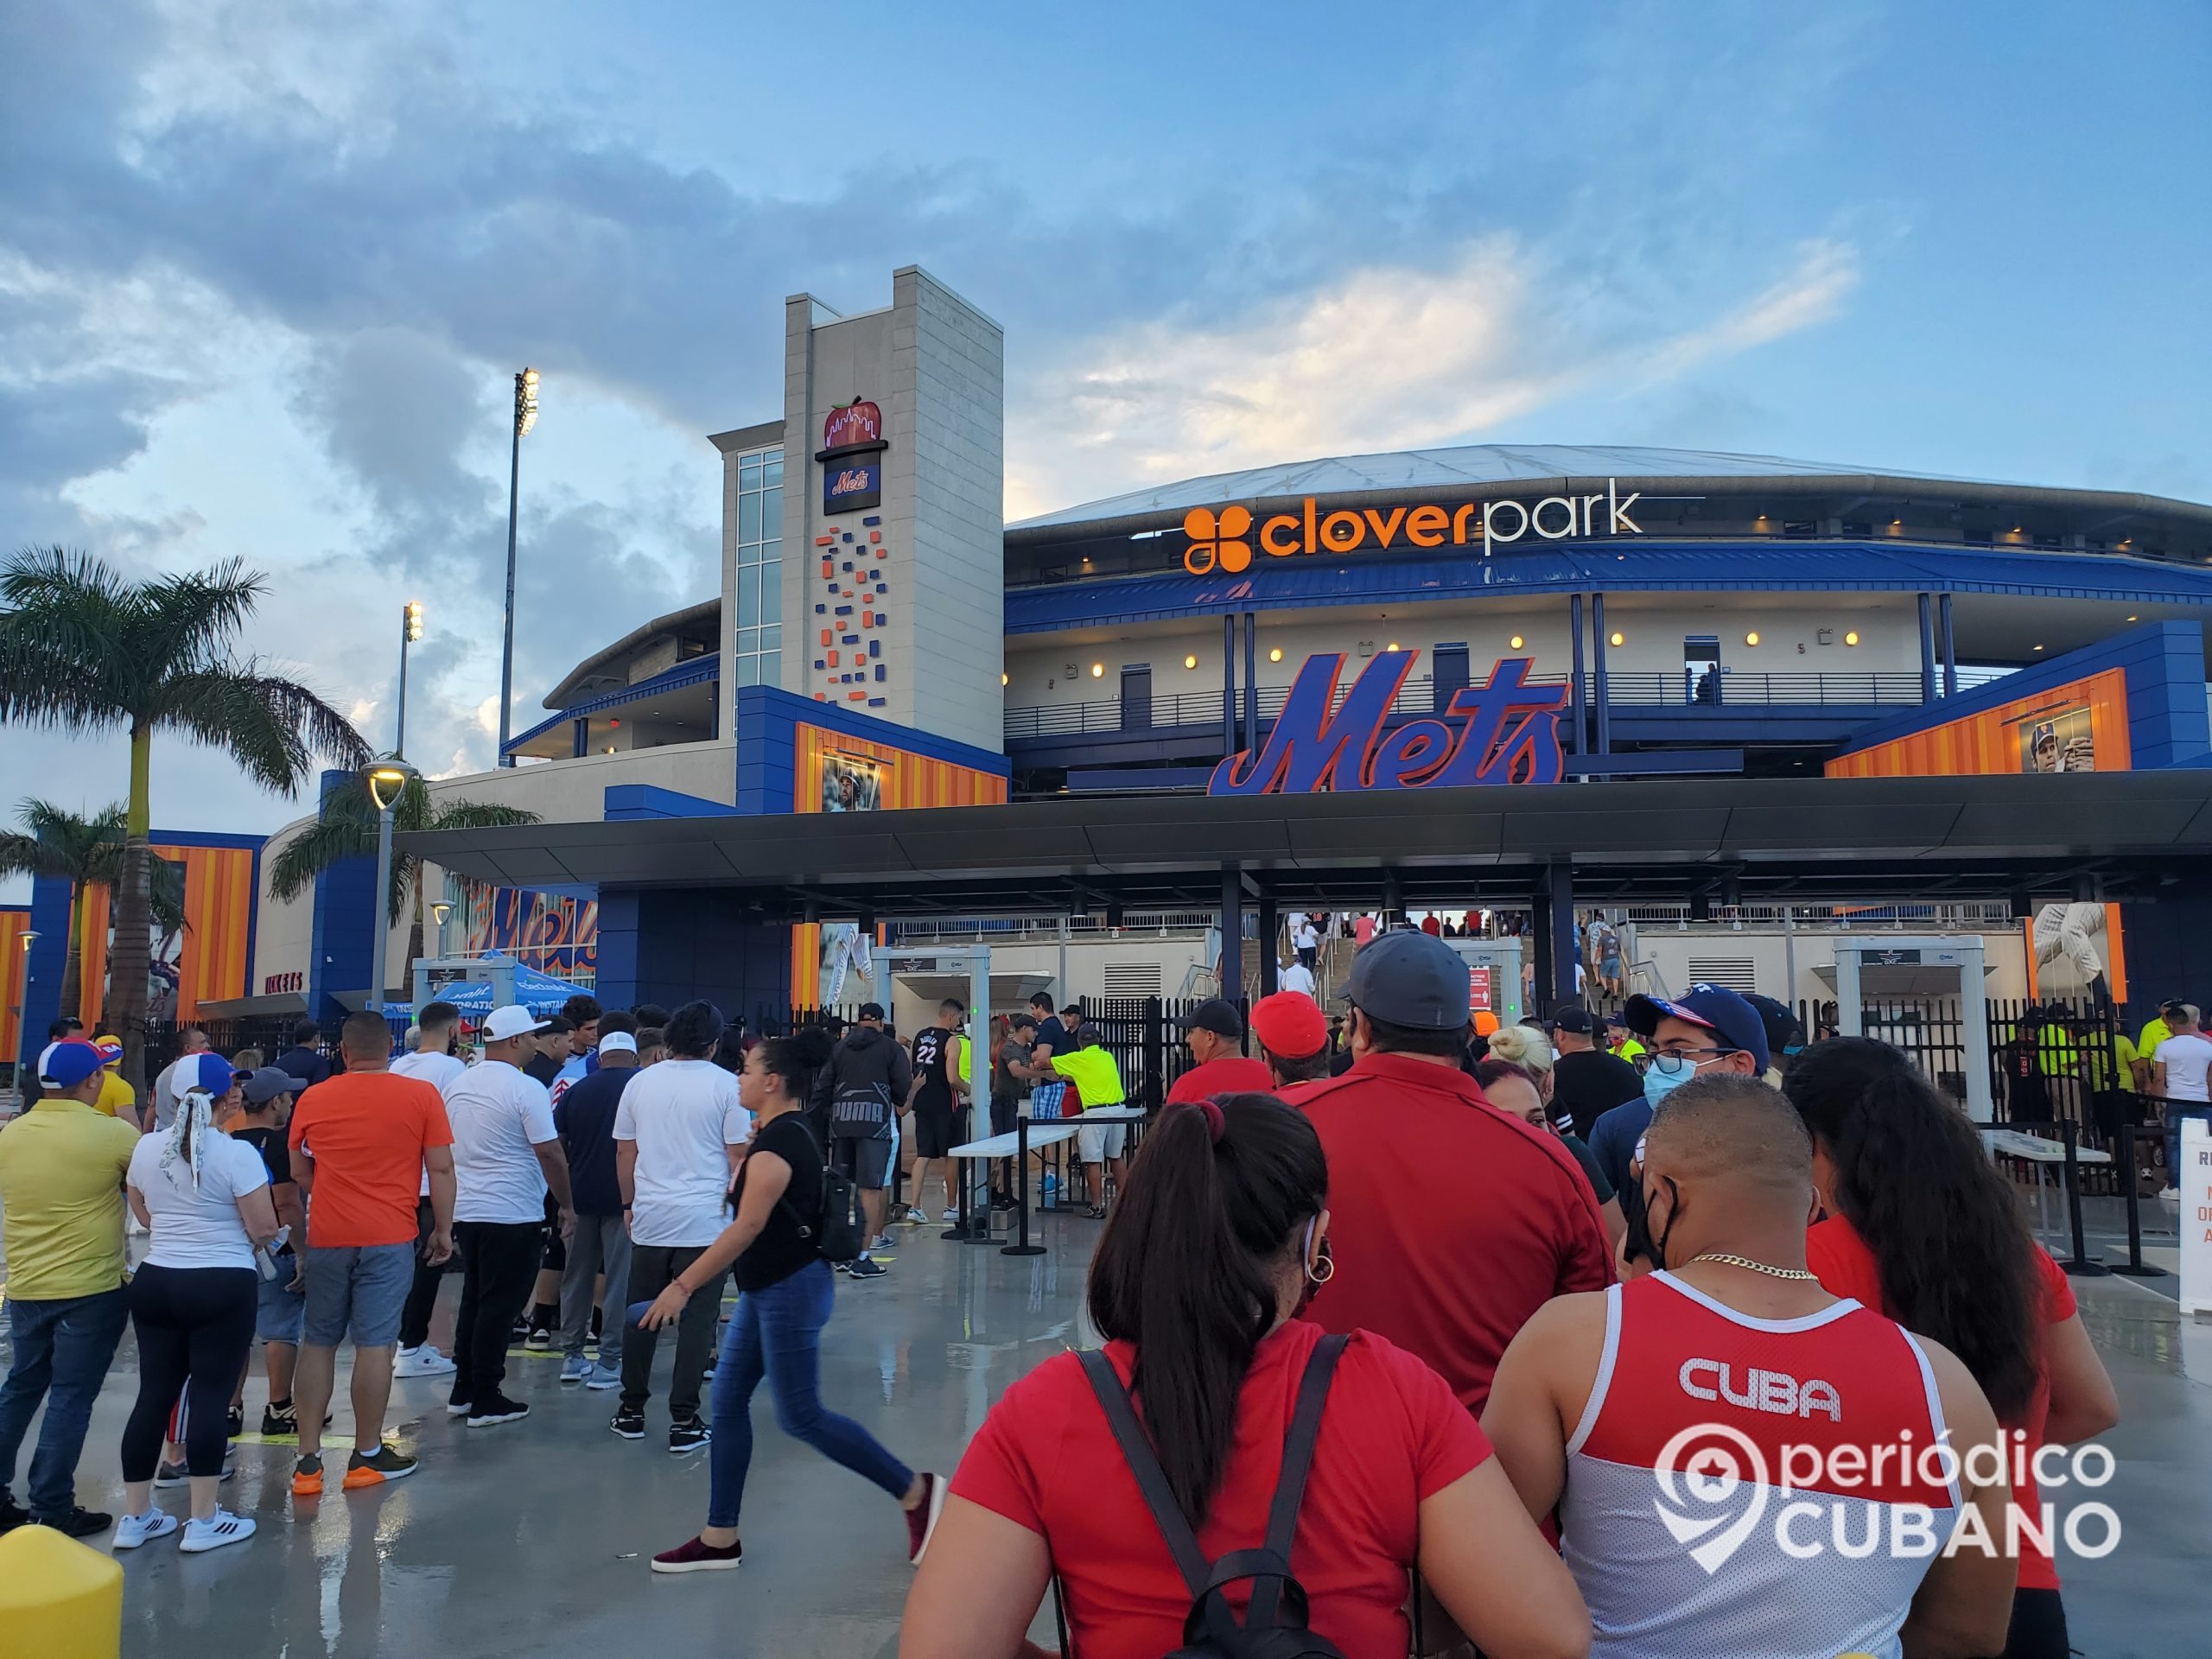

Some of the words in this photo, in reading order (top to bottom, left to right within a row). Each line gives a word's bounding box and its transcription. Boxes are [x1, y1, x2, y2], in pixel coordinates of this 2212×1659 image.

[831, 470, 869, 496] Mets
[1206, 649, 1573, 798] Mets
[264, 971, 303, 995] TICKETS
[916, 1045, 937, 1065] 22
[831, 1101, 884, 1123] PUMA
[1678, 1357, 1842, 1423] CUBA
